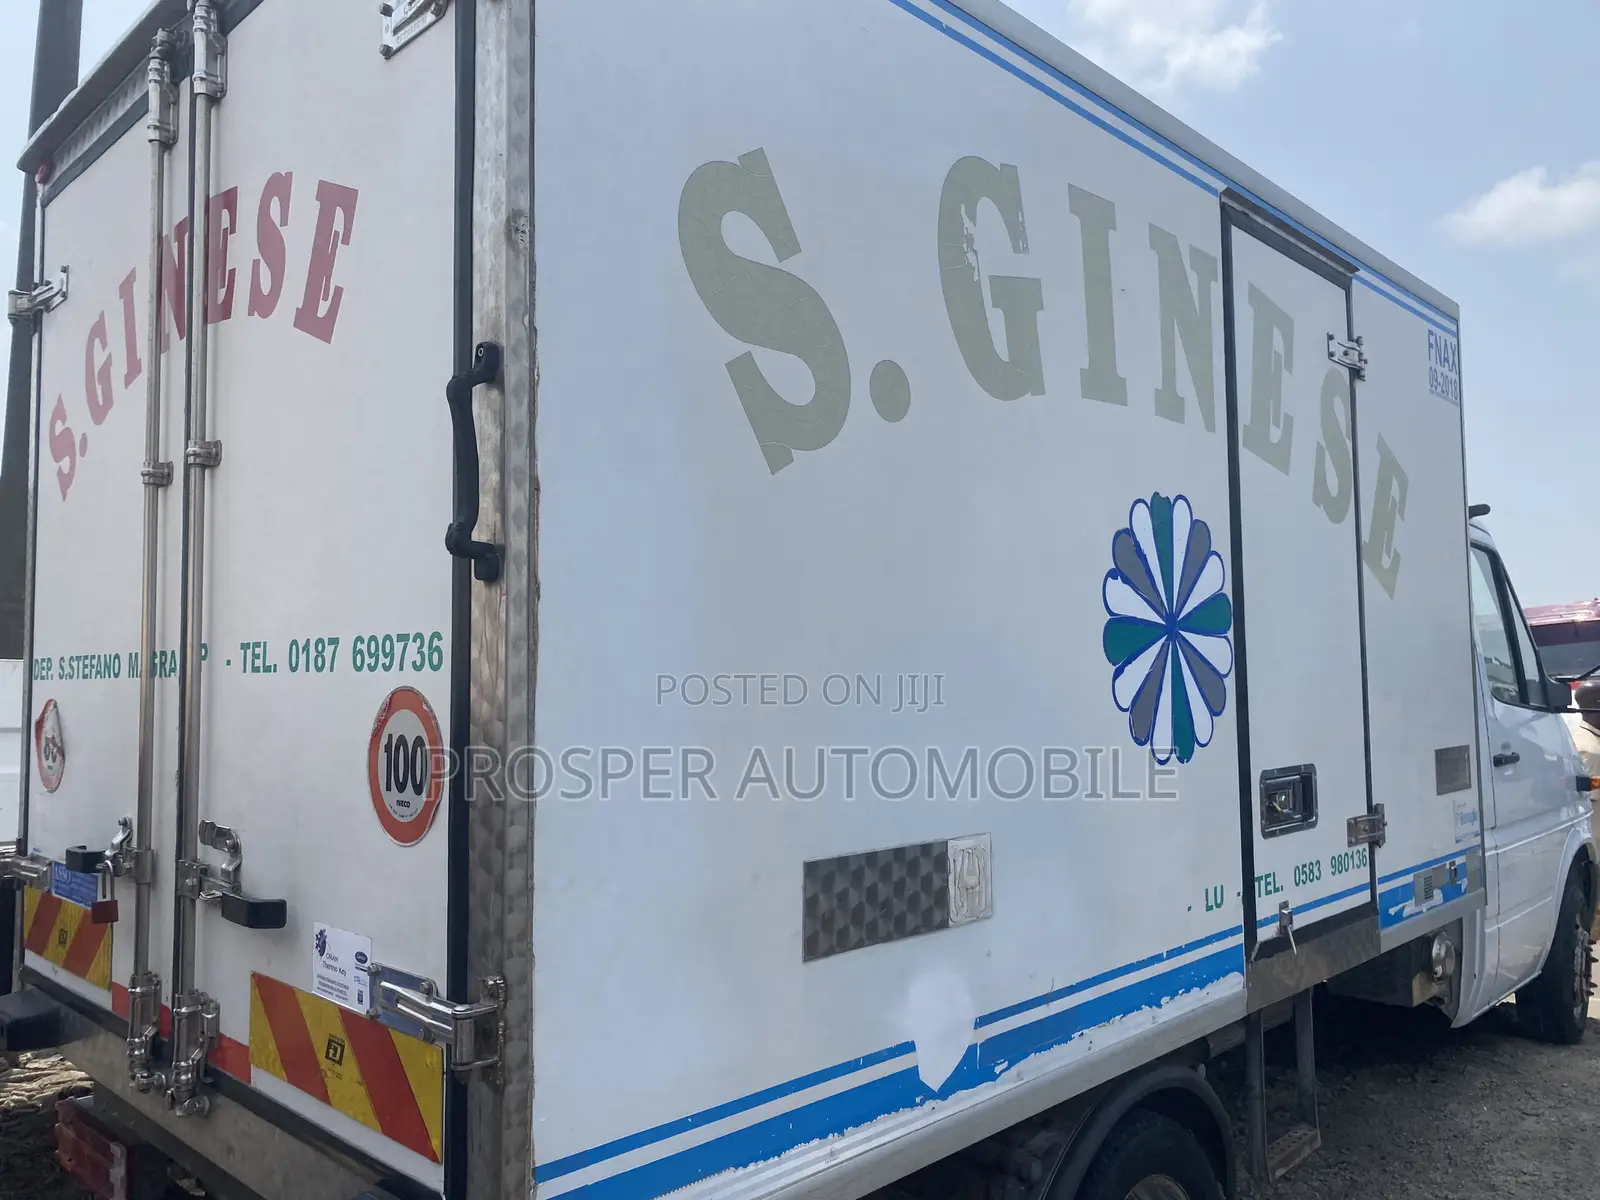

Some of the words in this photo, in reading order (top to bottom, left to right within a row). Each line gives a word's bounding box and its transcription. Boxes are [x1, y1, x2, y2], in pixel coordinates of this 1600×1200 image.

[1428, 328, 1458, 375] FNAX
[1429, 366, 1458, 401] 09-2018
[33, 657, 54, 681] DEP.
[240, 641, 277, 674] TEL.
[288, 637, 340, 673] 0187
[352, 631, 443, 672] 699736
[384, 733, 428, 796] 100
[1205, 885, 1224, 912] LU
[1254, 871, 1284, 898] TEL.
[1293, 860, 1322, 887] 0583
[1330, 847, 1368, 876] 980136
